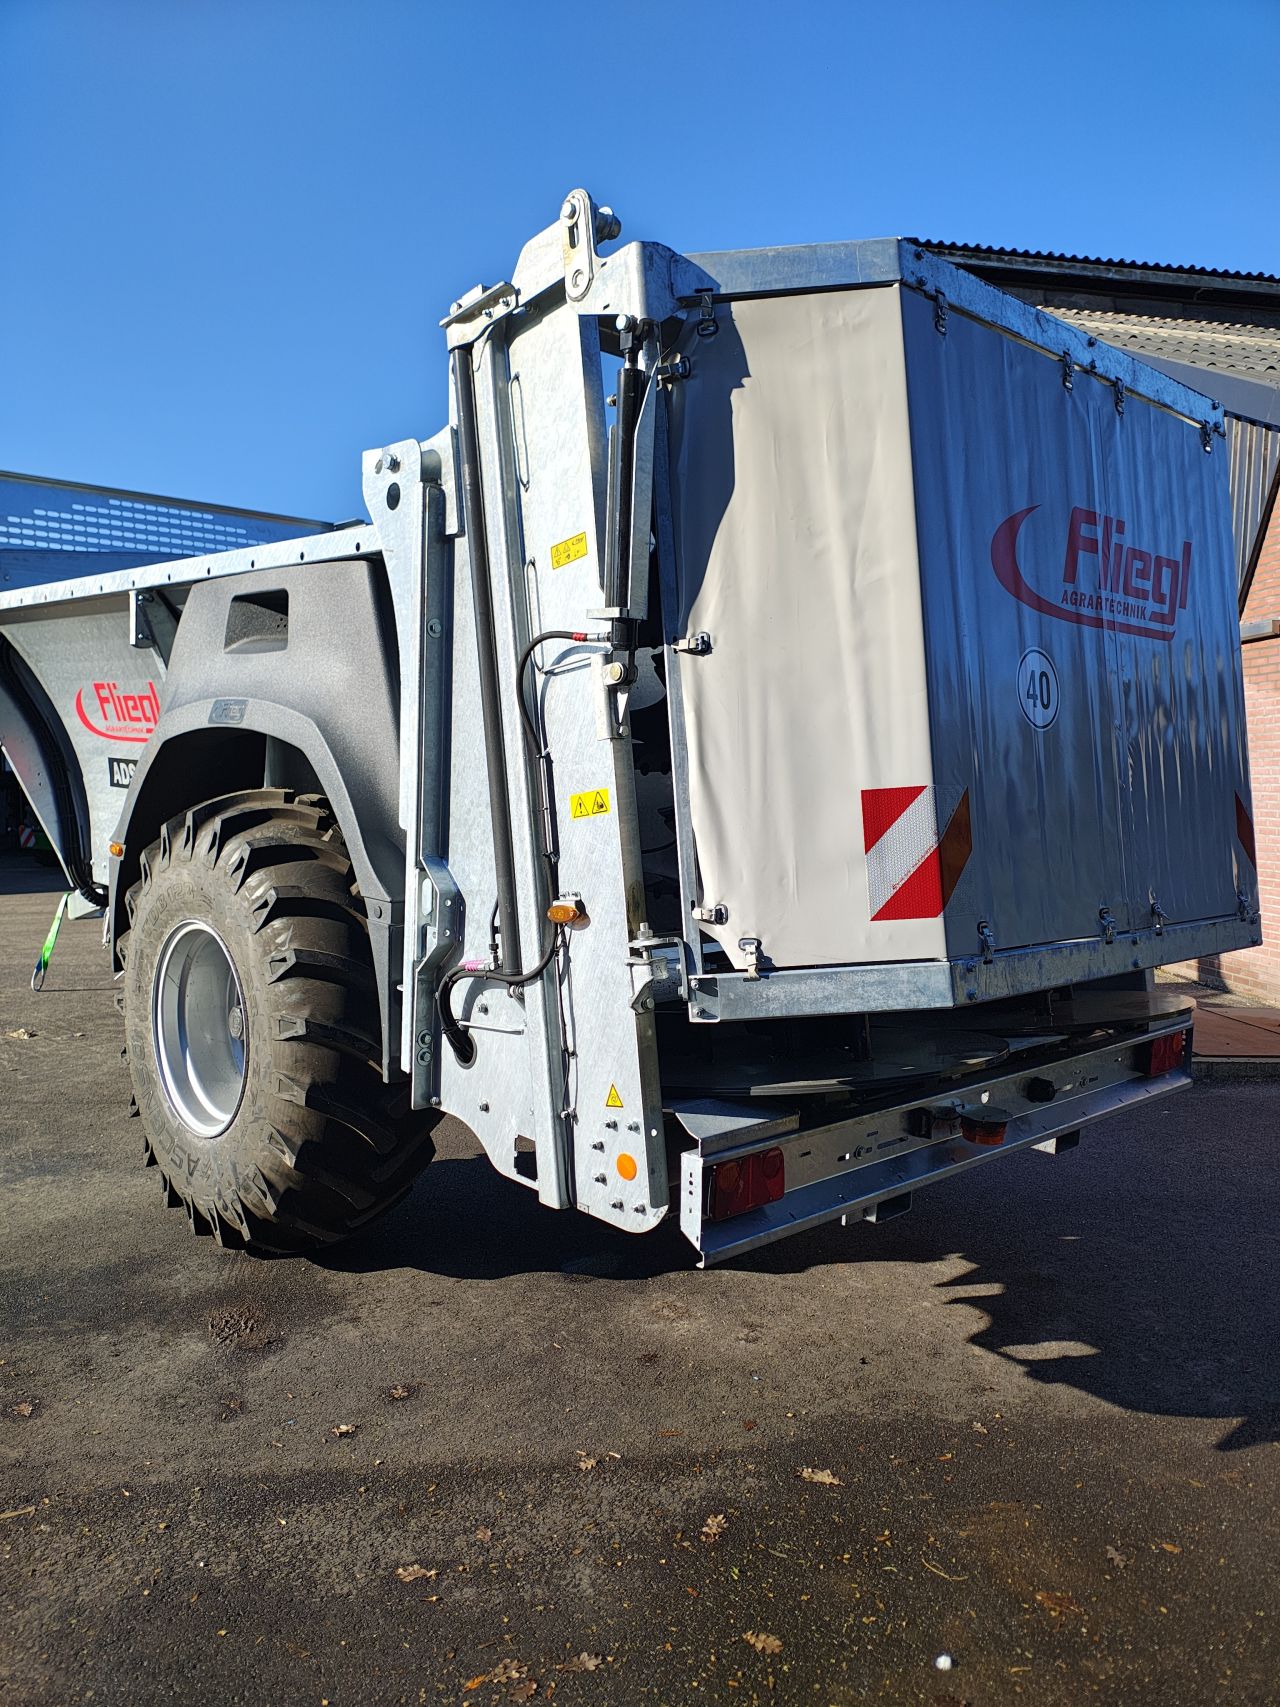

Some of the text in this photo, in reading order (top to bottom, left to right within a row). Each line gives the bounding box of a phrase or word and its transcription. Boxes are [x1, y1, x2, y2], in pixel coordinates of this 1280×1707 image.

[1063, 506, 1192, 625] Fliegl
[1061, 589, 1147, 621] AGRARTECHNIK
[93, 681, 160, 733] Fliegl
[1026, 669, 1051, 710] 40
